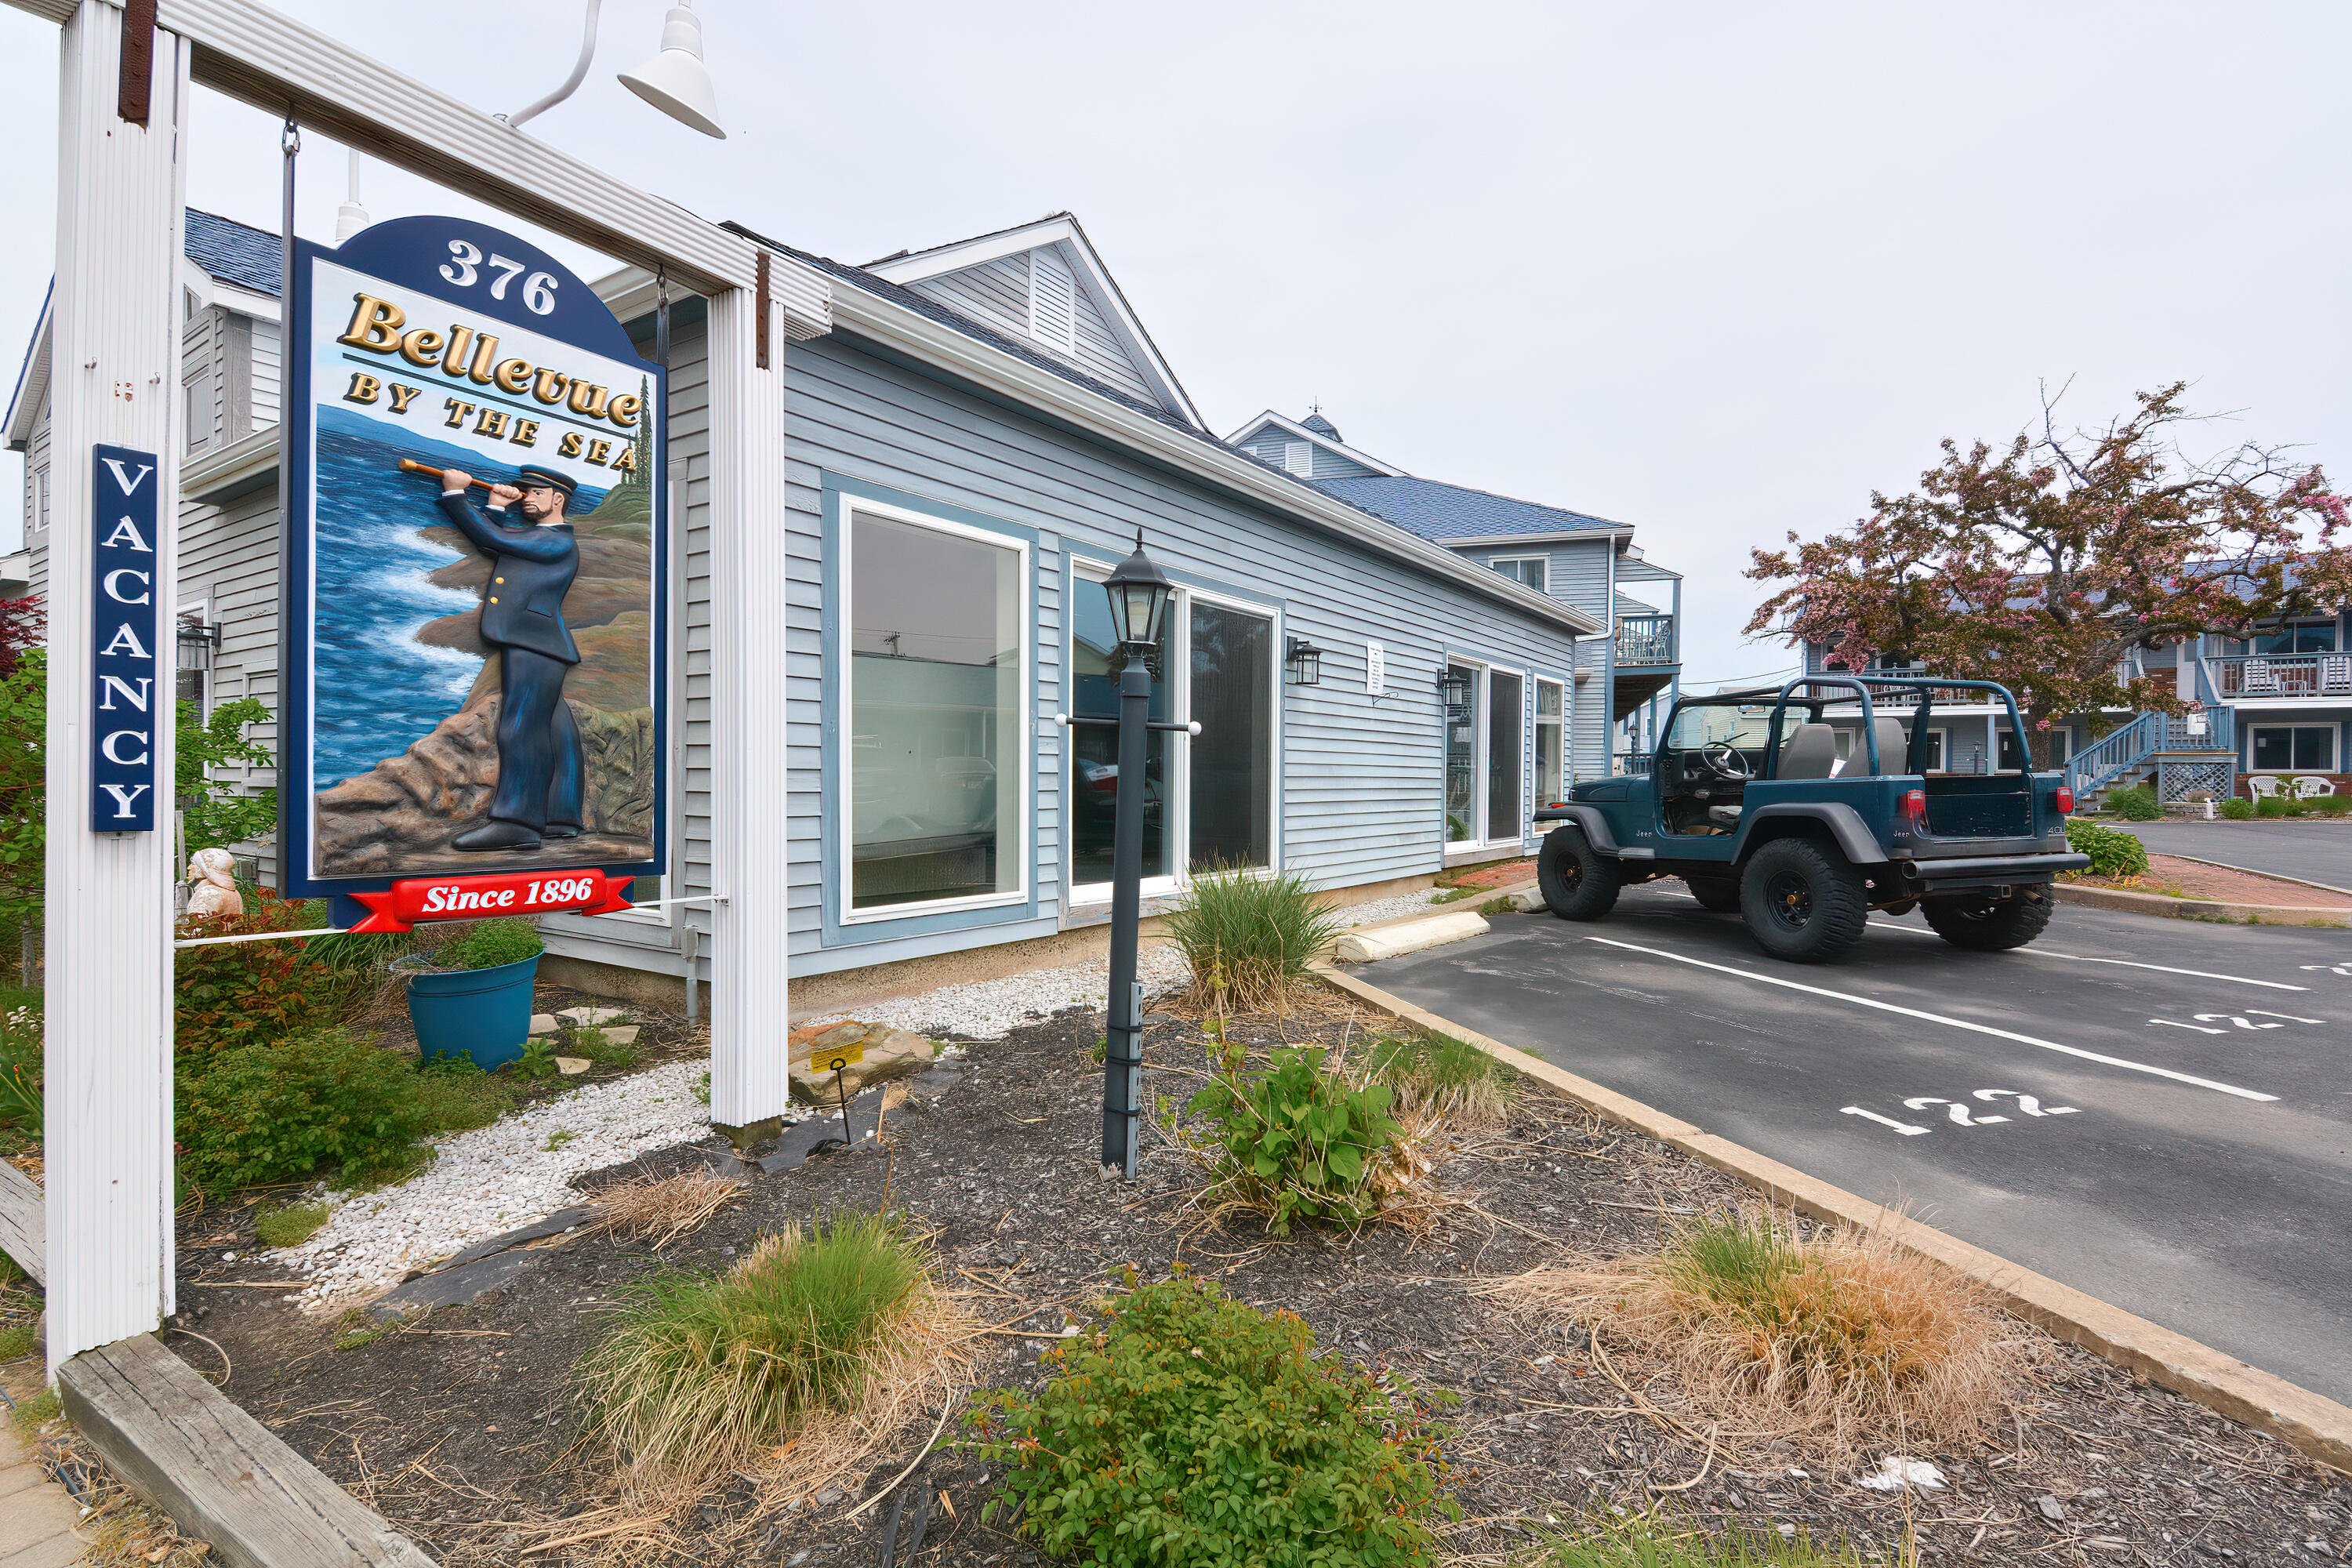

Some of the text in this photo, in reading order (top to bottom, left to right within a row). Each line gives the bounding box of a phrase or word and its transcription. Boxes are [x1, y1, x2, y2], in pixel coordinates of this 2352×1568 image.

[439, 239, 560, 316] 376
[337, 292, 642, 429] Bellevue
[343, 372, 637, 471] BY THE SEA
[100, 457, 154, 819] VACANCY
[422, 878, 593, 913] Since 1896
[2147, 1009, 2327, 1034] 121
[1838, 1089, 2082, 1136] 122
